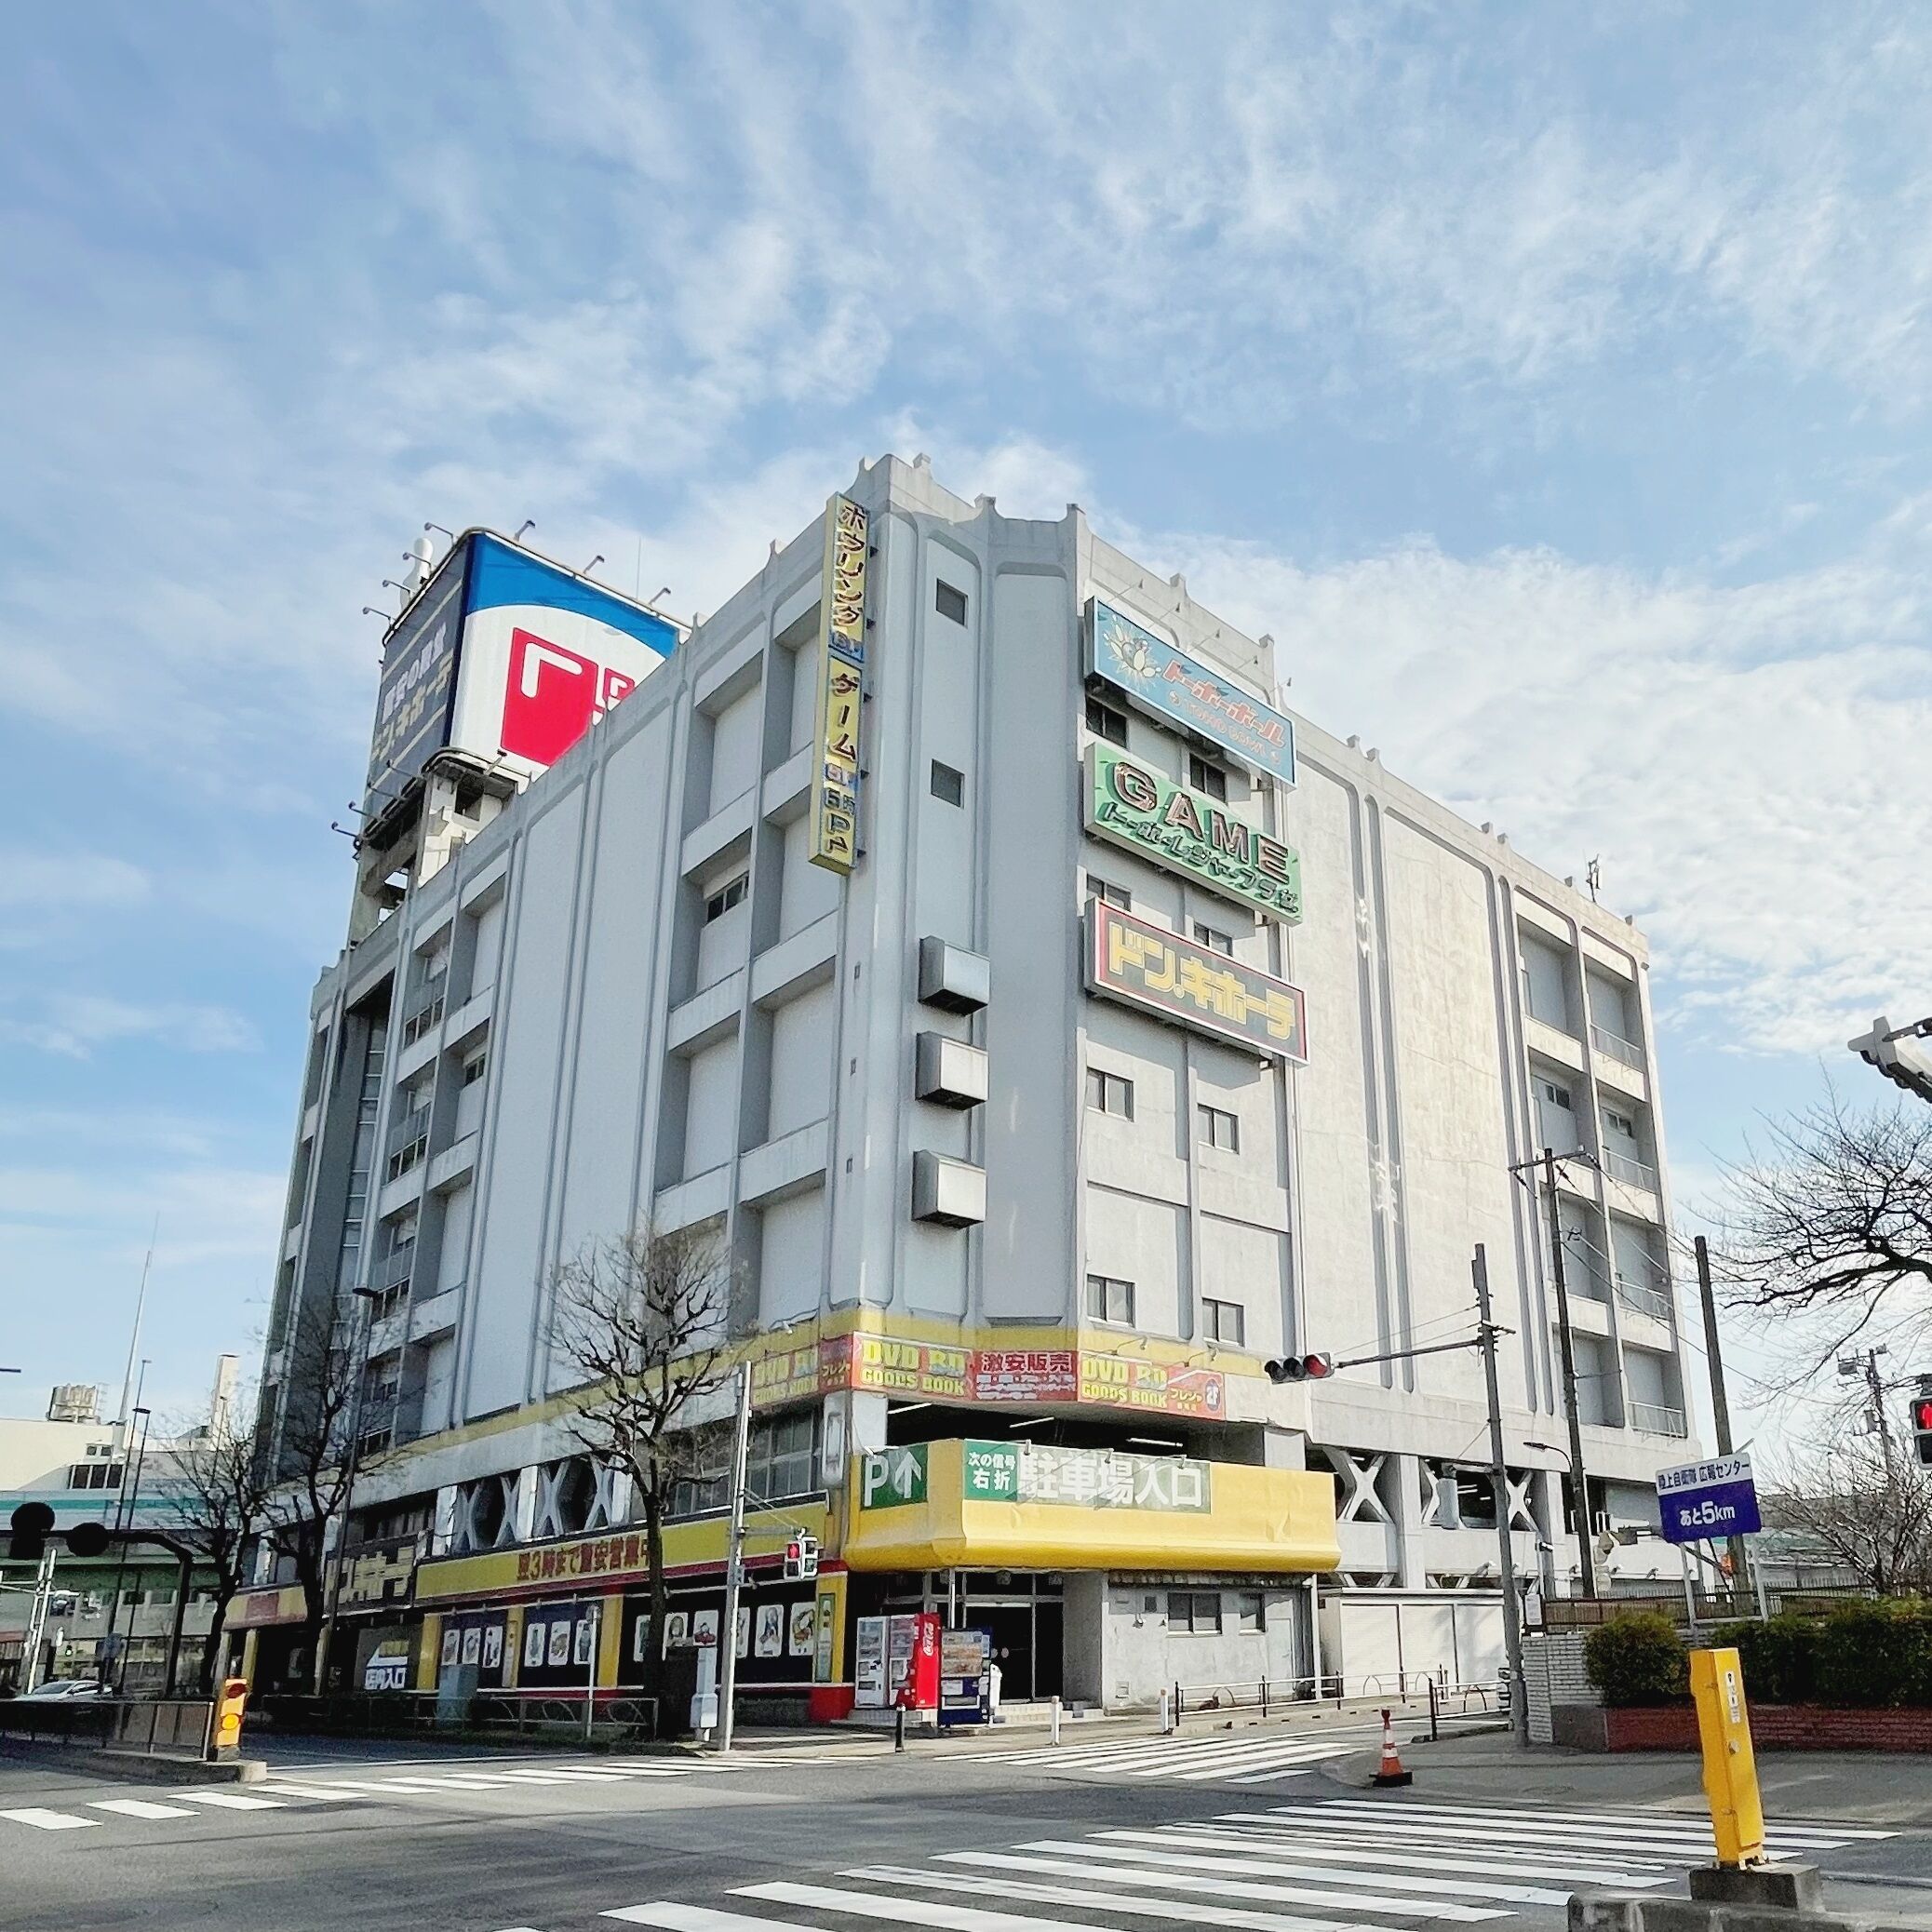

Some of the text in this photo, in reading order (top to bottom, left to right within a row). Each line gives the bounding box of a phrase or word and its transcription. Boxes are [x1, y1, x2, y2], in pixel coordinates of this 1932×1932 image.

[831, 672, 859, 762] ゲーム
[1109, 761, 1290, 885] GAME
[863, 1339, 919, 1370] DVD
[982, 1352, 1071, 1373] 激安販売
[860, 1368, 917, 1390] GOODS
[921, 1377, 964, 1397] BOOK
[1082, 1359, 1126, 1383] DVD
[1081, 1382, 1127, 1403] GOODS
[1131, 1389, 1167, 1409] BOOK
[967, 1451, 1016, 1471] 次の信号
[864, 1456, 890, 1507] P
[973, 1468, 1011, 1491] 右折
[1019, 1452, 1203, 1508] 駐車場入口
